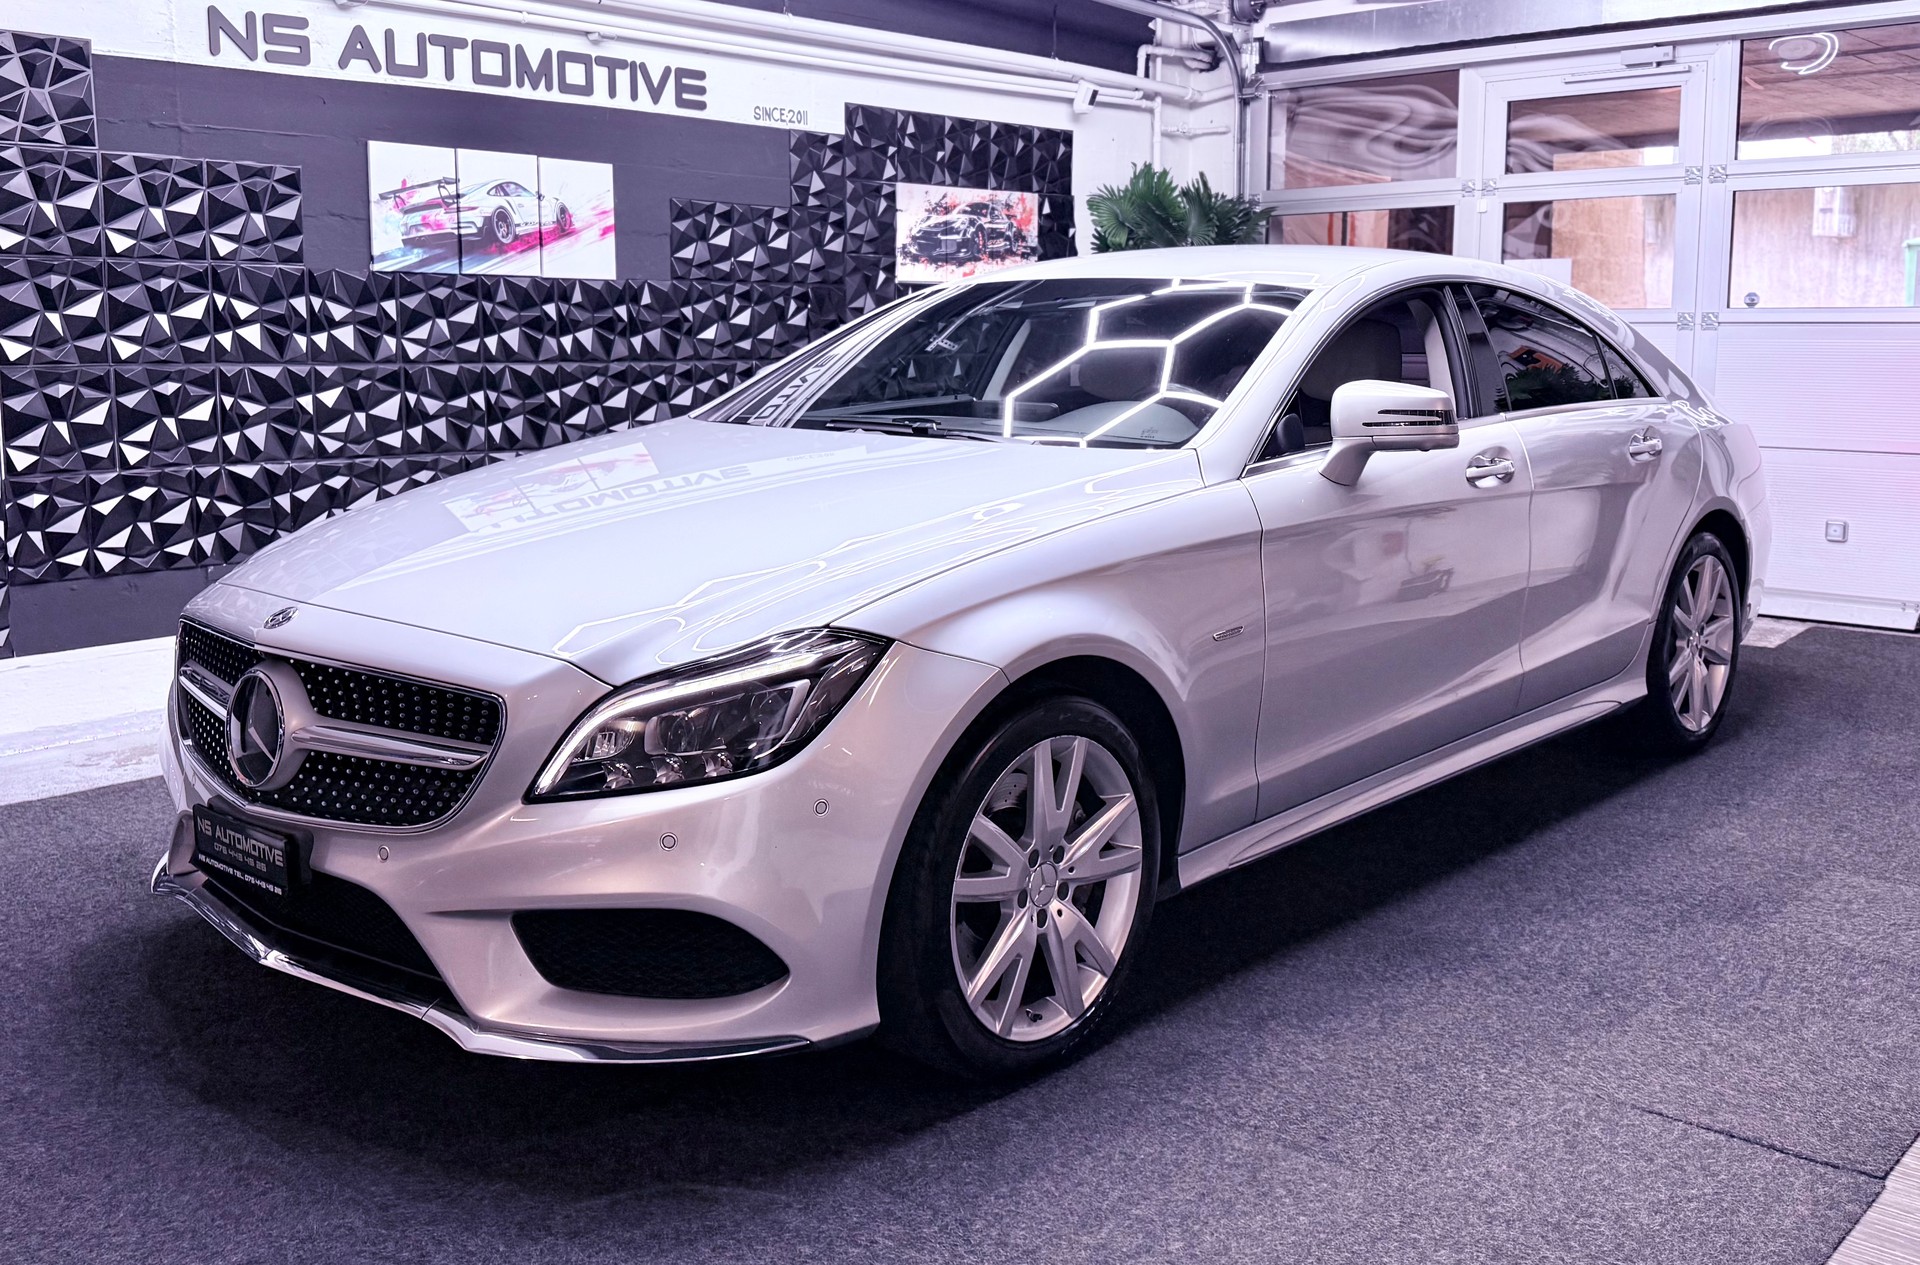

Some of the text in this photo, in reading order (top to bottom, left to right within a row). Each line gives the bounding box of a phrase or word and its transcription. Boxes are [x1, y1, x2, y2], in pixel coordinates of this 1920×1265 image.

[207, 5, 708, 112] NS AUTOMOTIVE
[197, 816, 284, 867] NS AUTOMOTIVE
[206, 856, 233, 874] AUTOMOTIVE
